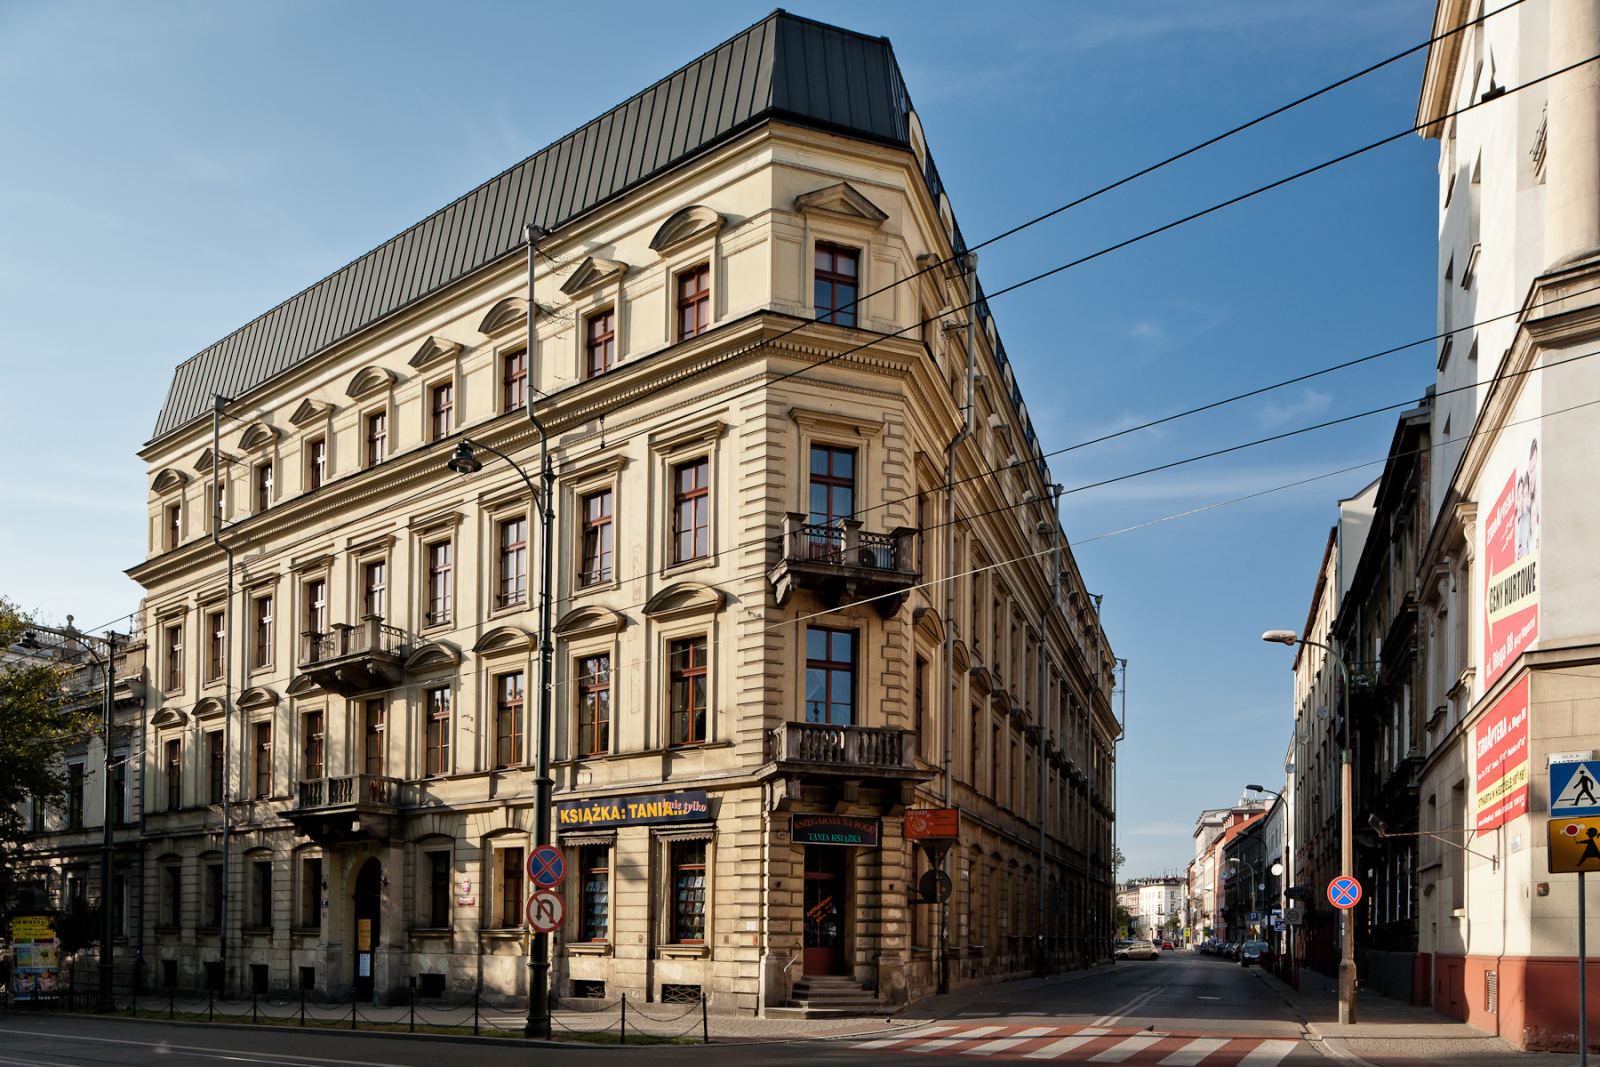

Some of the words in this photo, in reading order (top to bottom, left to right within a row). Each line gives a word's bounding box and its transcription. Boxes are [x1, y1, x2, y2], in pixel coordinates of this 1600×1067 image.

[1489, 581, 1504, 614] CENY
[1504, 561, 1536, 607] HURTOWE
[560, 803, 626, 825] KSIĄŻKA:
[683, 799, 707, 814] tylko
[808, 832, 830, 841] TANIA
[831, 833, 862, 844] KSIĄŻKA
